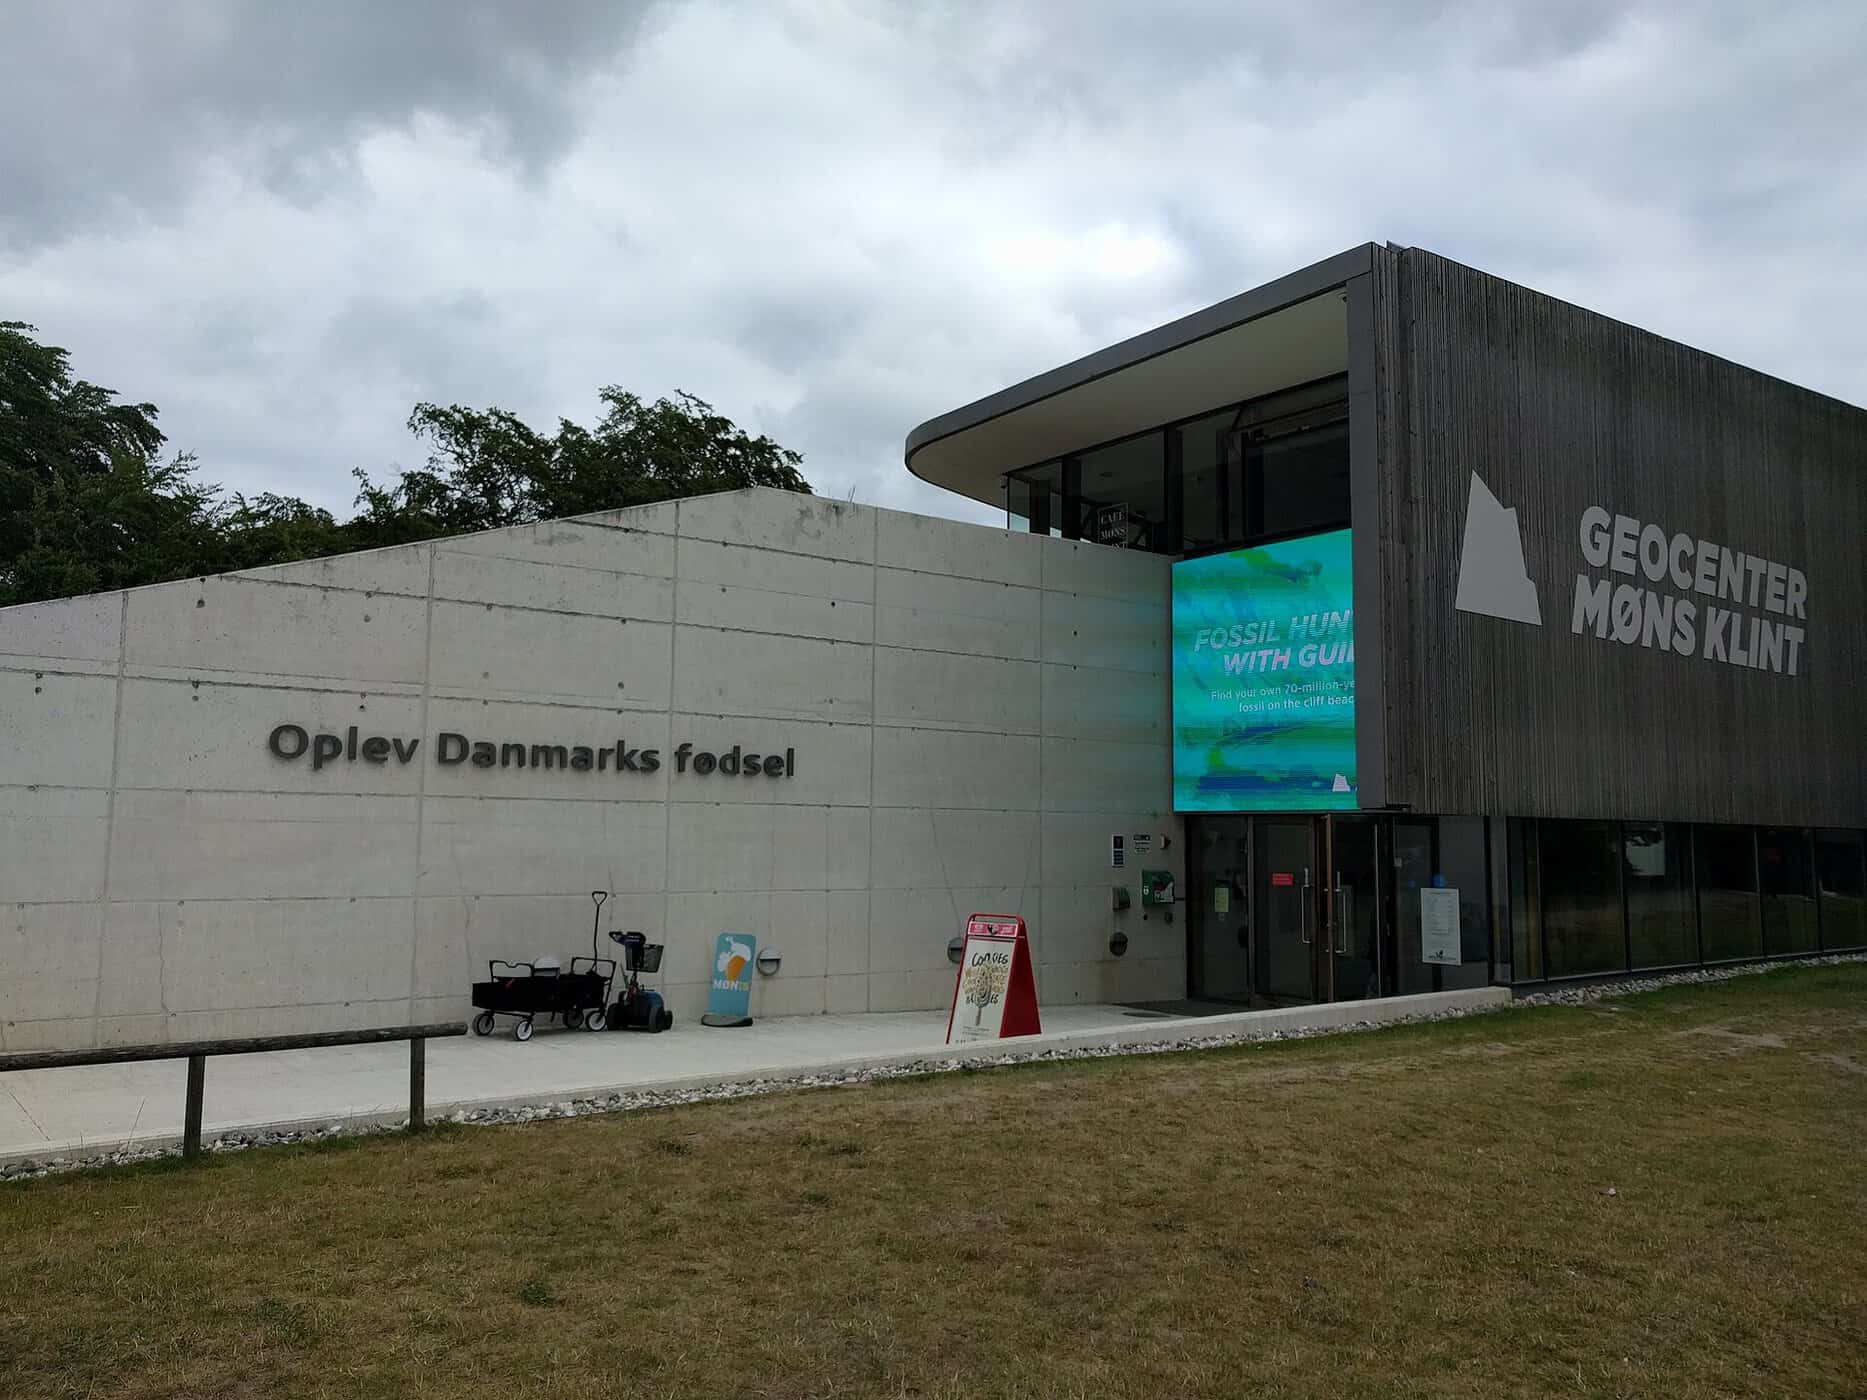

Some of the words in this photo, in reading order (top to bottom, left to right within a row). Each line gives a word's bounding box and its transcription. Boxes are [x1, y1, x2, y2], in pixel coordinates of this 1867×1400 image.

[1580, 505, 1808, 620] GEOCENTER
[1193, 620, 1280, 652] FOSSIL
[1289, 609, 1354, 640] HUN
[1571, 573, 1697, 656] MØNS
[1703, 606, 1806, 676] KLINT
[1224, 647, 1292, 676] WITH
[1211, 688, 1233, 701] Find
[1235, 689, 1257, 701] your
[1260, 687, 1281, 697] own
[1239, 701, 1265, 713] fossil
[1268, 701, 1281, 711] on
[1284, 698, 1301, 709] the
[1303, 695, 1325, 708] cliff
[269, 724, 420, 770] Oplev
[438, 733, 660, 773] Danmarks
[674, 743, 795, 777] fødsel
